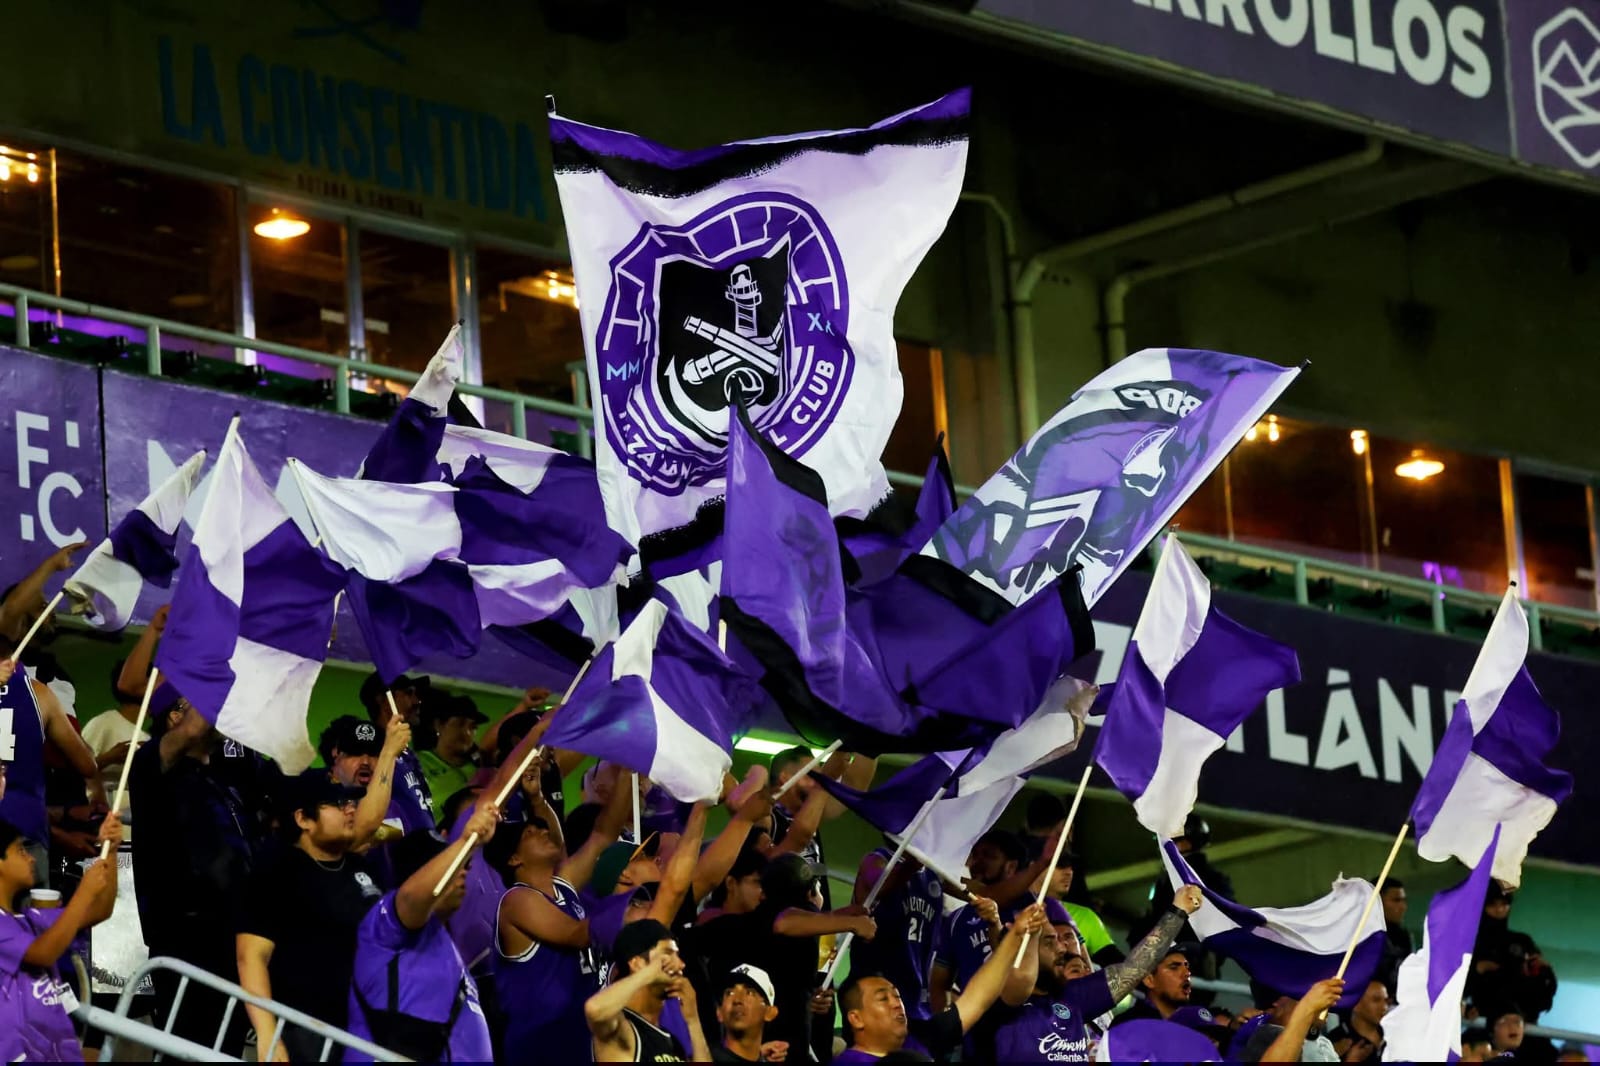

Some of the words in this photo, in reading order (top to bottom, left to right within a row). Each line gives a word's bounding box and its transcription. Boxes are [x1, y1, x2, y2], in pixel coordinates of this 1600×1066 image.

[158, 34, 226, 147] LA
[238, 53, 546, 222] CONSENTIDA
[606, 357, 640, 381] MM
[791, 360, 835, 425] CLUB
